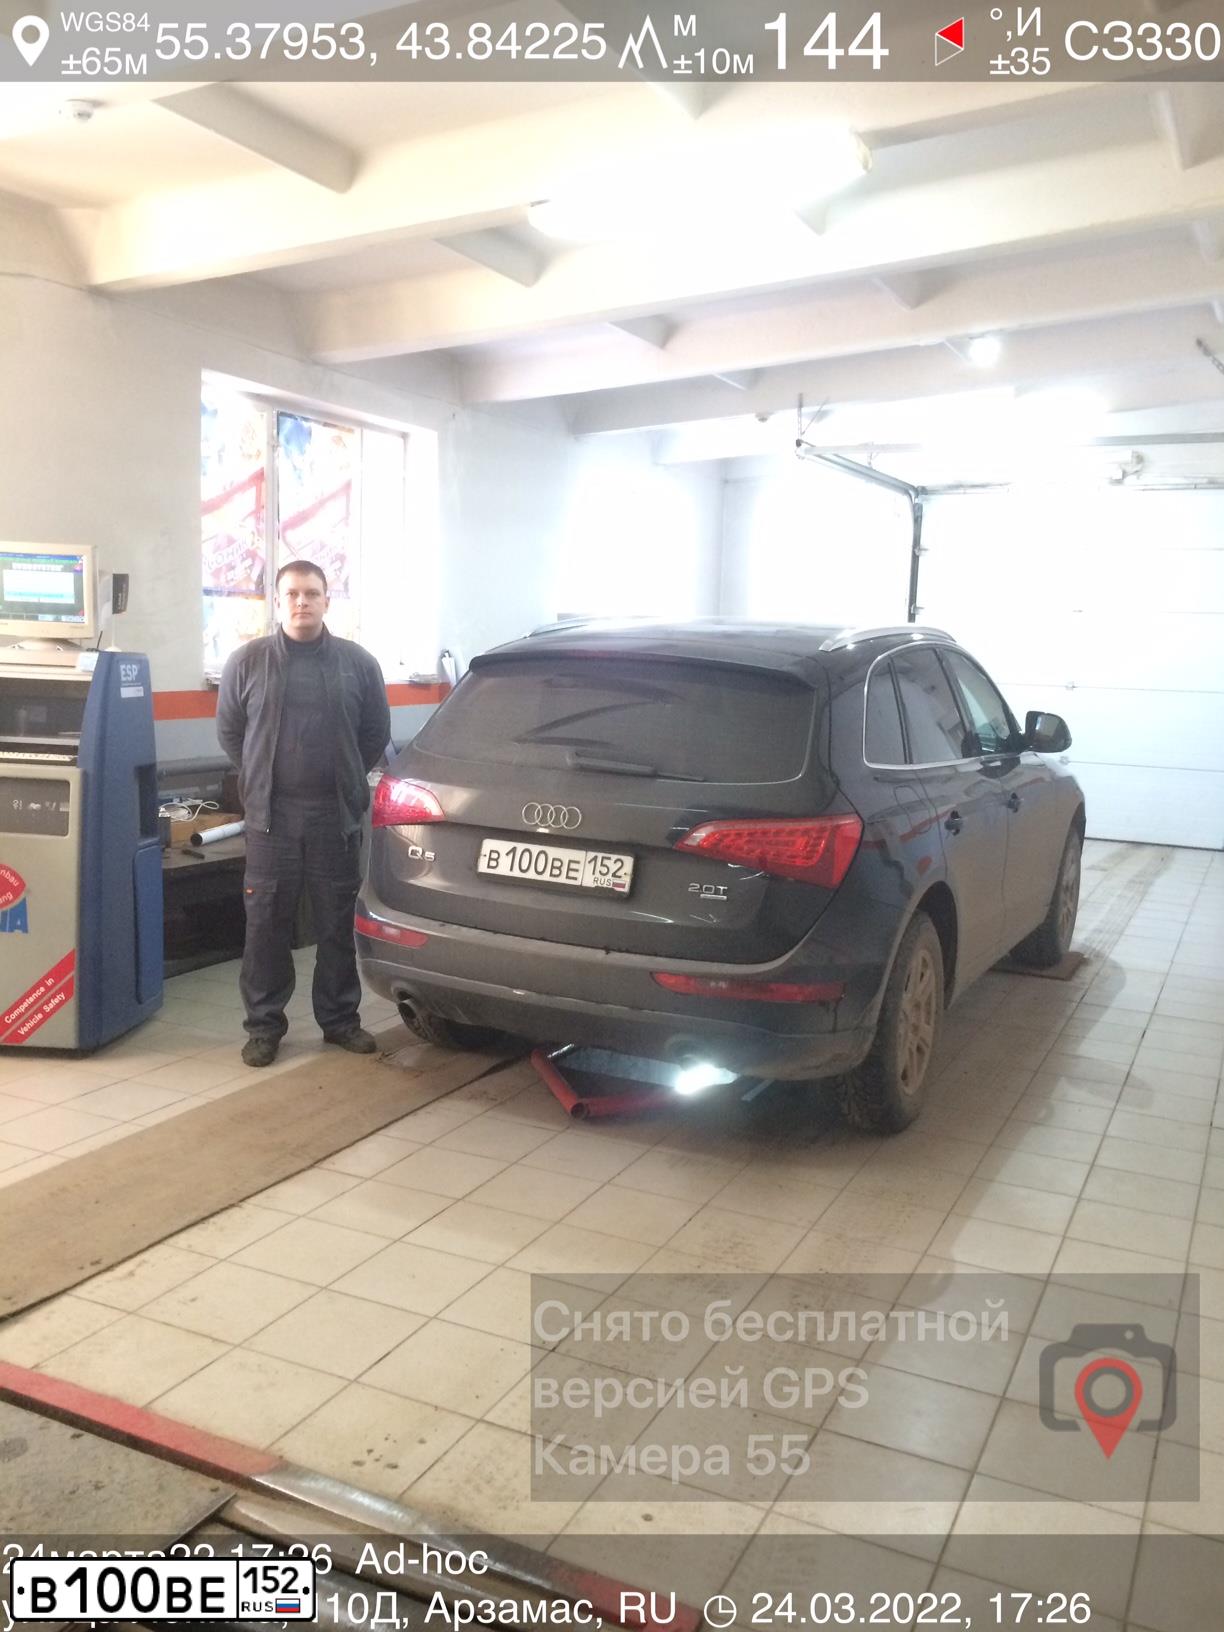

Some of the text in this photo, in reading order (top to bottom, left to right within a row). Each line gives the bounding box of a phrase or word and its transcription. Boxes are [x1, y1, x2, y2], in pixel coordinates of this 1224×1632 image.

[120, 664, 138, 682] ESP
[408, 845, 436, 862] Q5
[486, 845, 626, 881] В100ВЕ 152
[593, 876, 612, 888] RUS
[4, 986, 46, 1023] Competence
[17, 991, 66, 1036] Vehicle Safety
